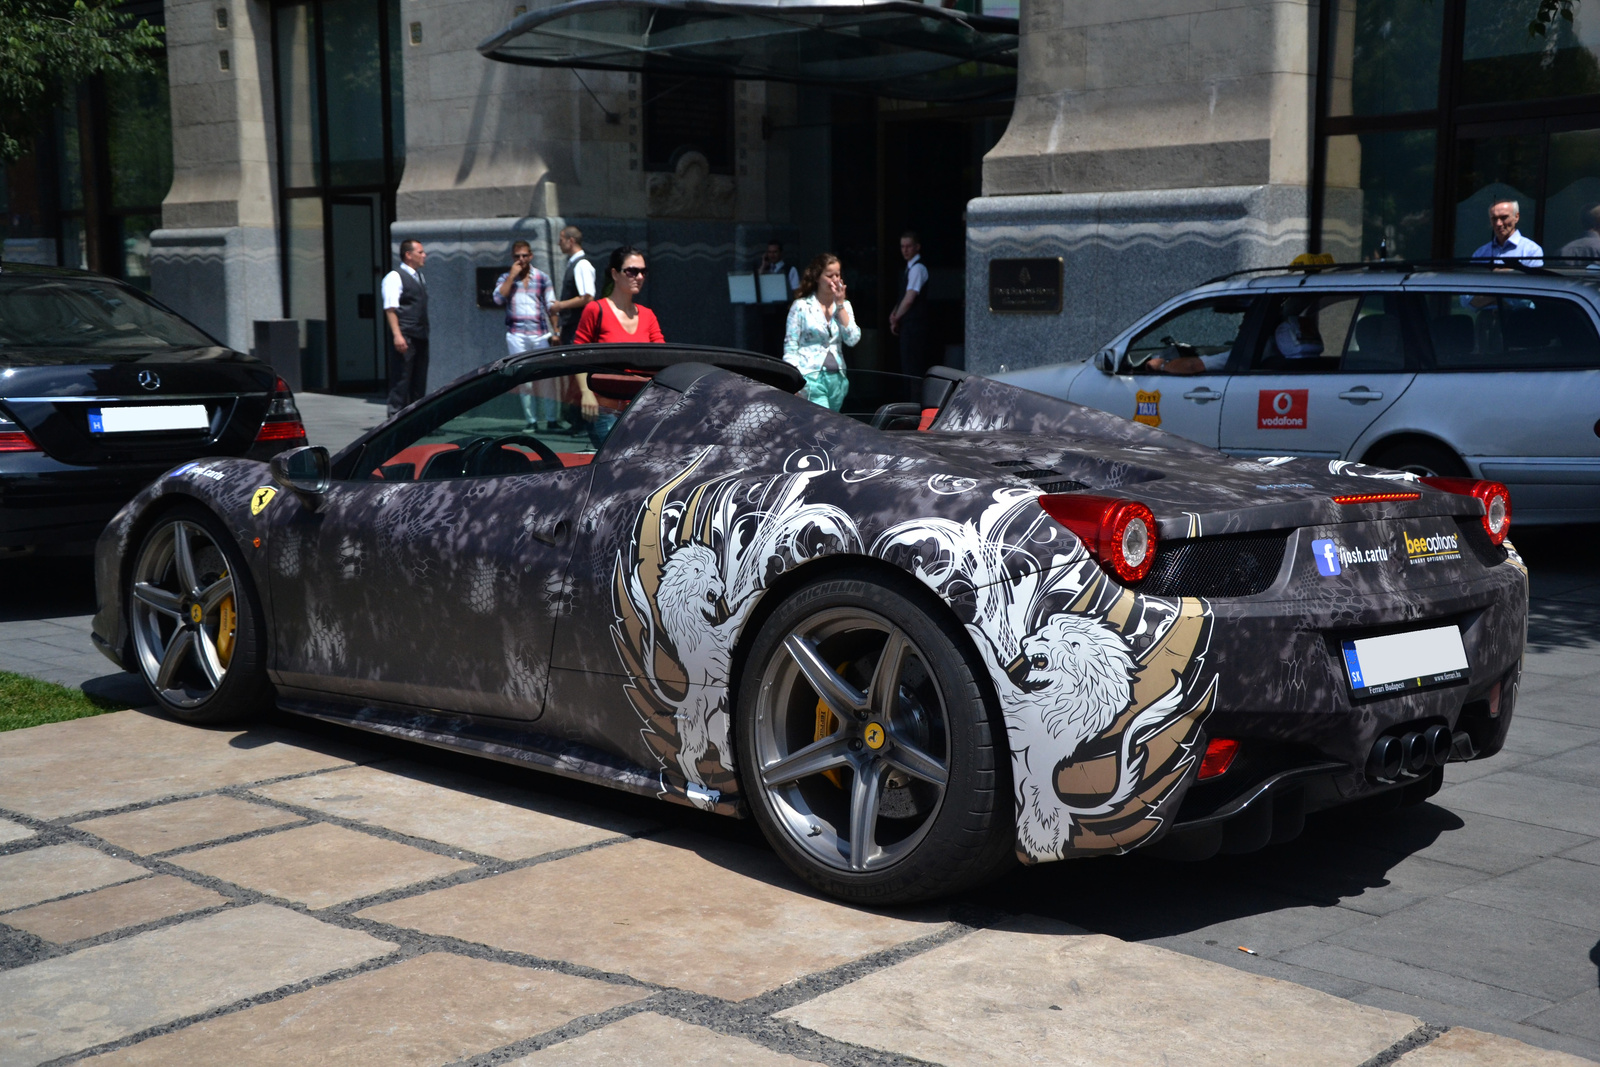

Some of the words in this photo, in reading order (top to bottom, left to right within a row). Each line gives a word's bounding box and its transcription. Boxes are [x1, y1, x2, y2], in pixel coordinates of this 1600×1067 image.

[1138, 402, 1157, 415] TAXI
[93, 421, 101, 430] H
[1261, 416, 1303, 426] vodafone
[1426, 555, 1444, 563] OPTIONS
[1445, 553, 1462, 561] TRADING
[795, 581, 865, 605] MICHELIN
[1351, 671, 1362, 683] SK
[1368, 686, 1385, 696] Ferrari
[1385, 681, 1405, 693] Budapest
